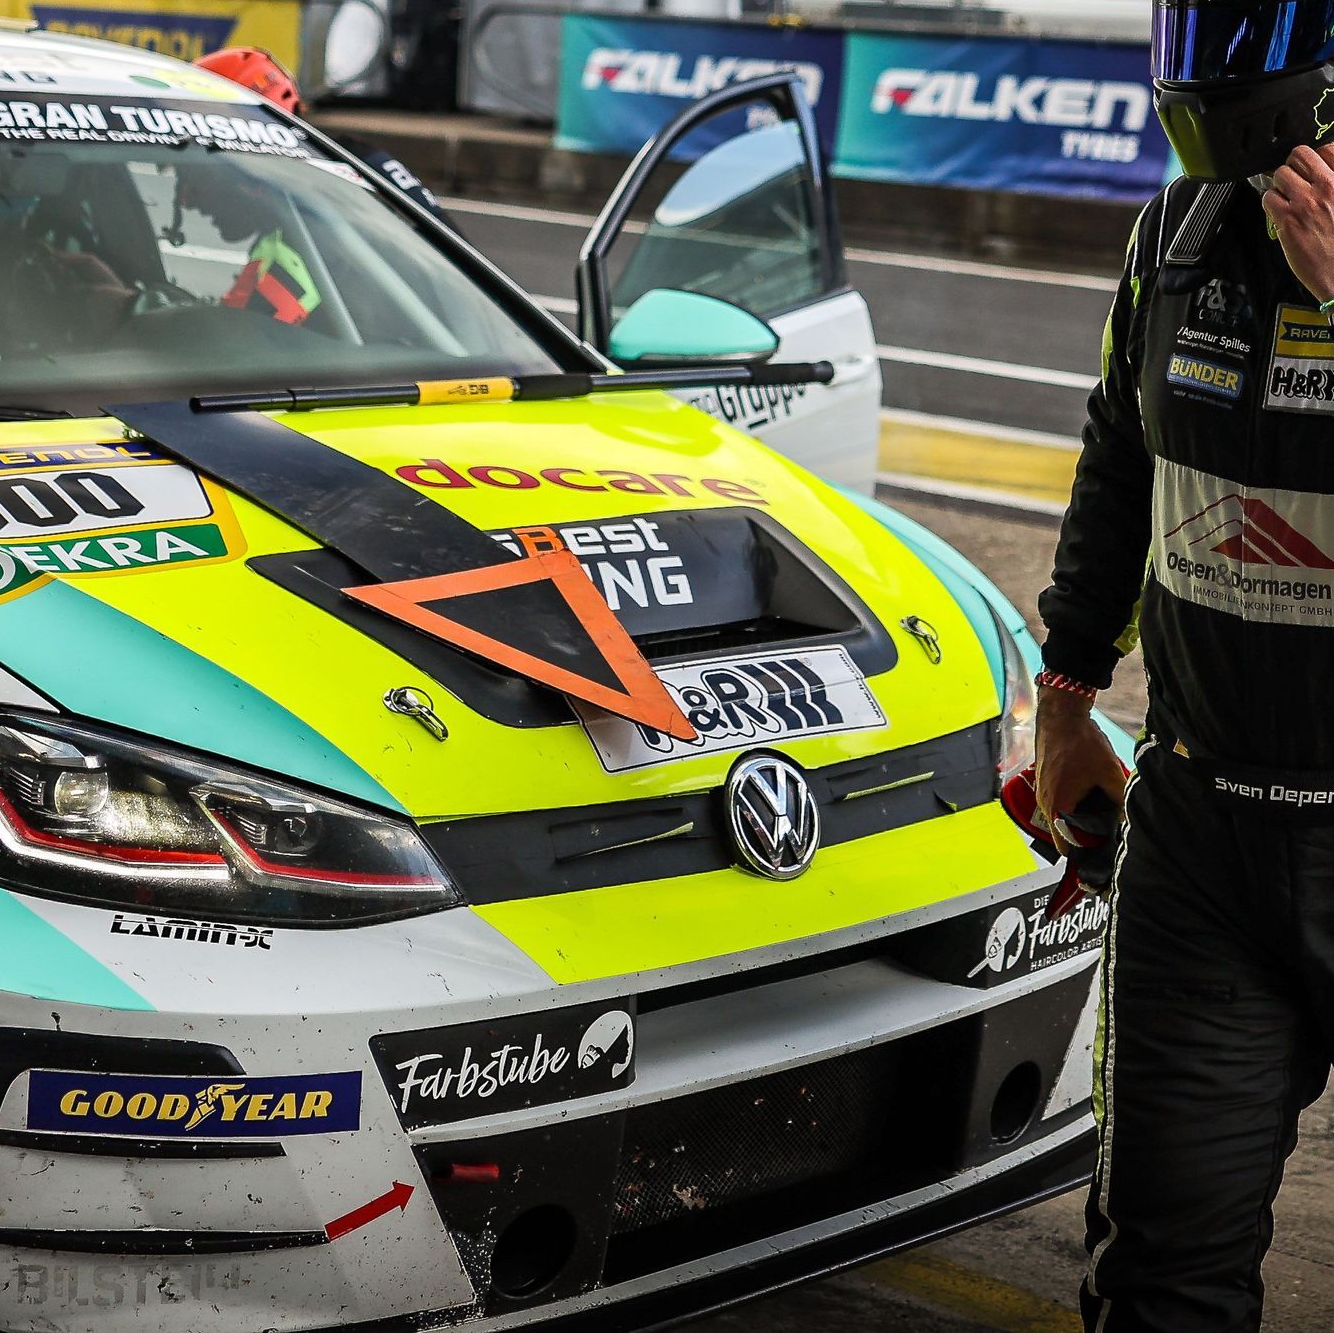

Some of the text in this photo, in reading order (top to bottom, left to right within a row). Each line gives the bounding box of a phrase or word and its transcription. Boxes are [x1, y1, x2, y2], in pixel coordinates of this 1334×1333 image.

[871, 68, 1150, 131] FALKEN
[44, 129, 108, 142] REAL
[1219, 334, 1252, 353] Spilles
[1169, 357, 1240, 391] BÜNDER
[1271, 366, 1326, 400] H&R
[396, 458, 769, 506] docare
[1299, 605, 1333, 617] GMBH
[1214, 777, 1264, 800] Sven
[395, 1033, 570, 1114] Farbstube
